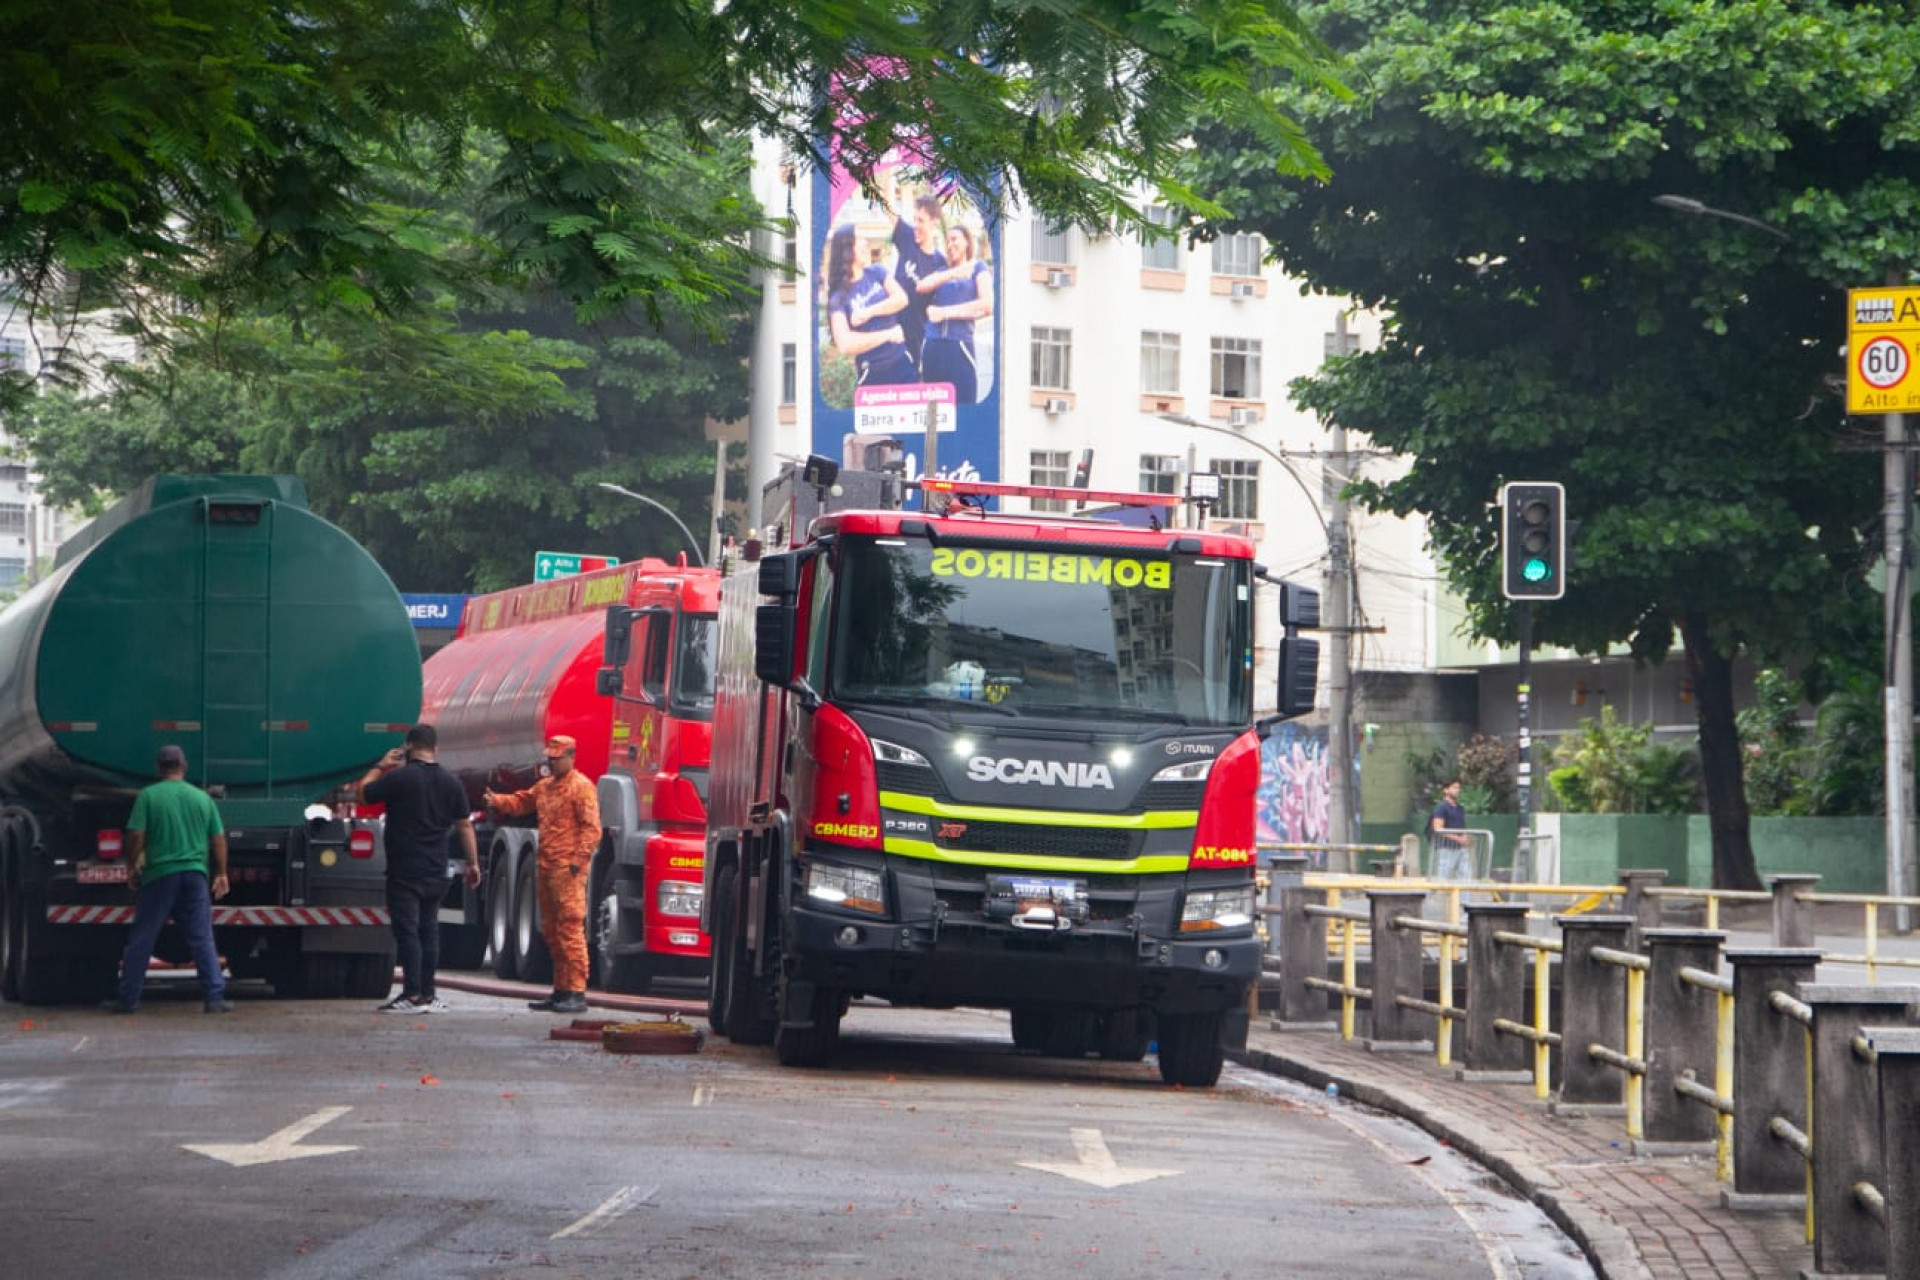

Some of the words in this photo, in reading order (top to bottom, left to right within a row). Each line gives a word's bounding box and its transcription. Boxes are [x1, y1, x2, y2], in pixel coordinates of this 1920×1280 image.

[1868, 346, 1899, 373] 60
[1863, 394, 1899, 407] Alto
[861, 414, 894, 426] Barra
[405, 604, 447, 618] MERJ
[966, 756, 1114, 790] SCANIA
[814, 822, 878, 838] CBMERJ
[1194, 846, 1248, 862] AT-084
[669, 857, 704, 868] CBME
